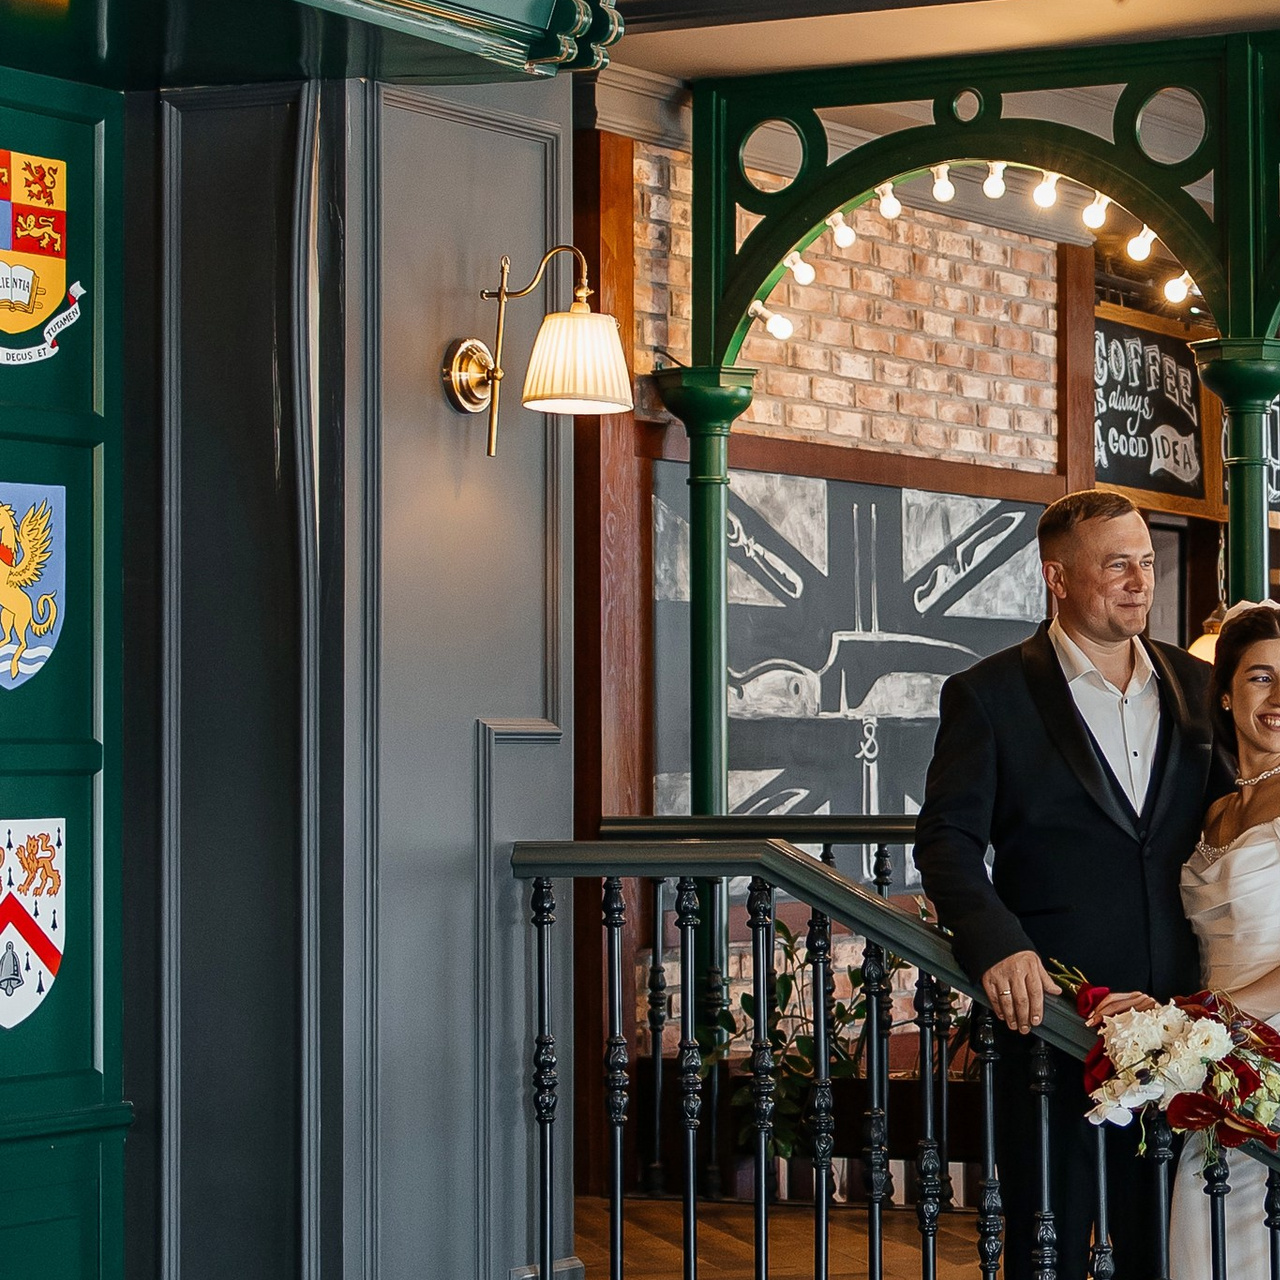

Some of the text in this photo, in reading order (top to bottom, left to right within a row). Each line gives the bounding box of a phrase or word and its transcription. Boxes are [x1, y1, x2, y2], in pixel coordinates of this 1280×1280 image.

[5, 308, 79, 361] DECUS ET TUTAMEN
[1094, 331, 1198, 426] COFFEE
[1108, 385, 1154, 435] always
[1108, 427, 1149, 458] GOOD
[1154, 437, 1193, 470] IDEA
